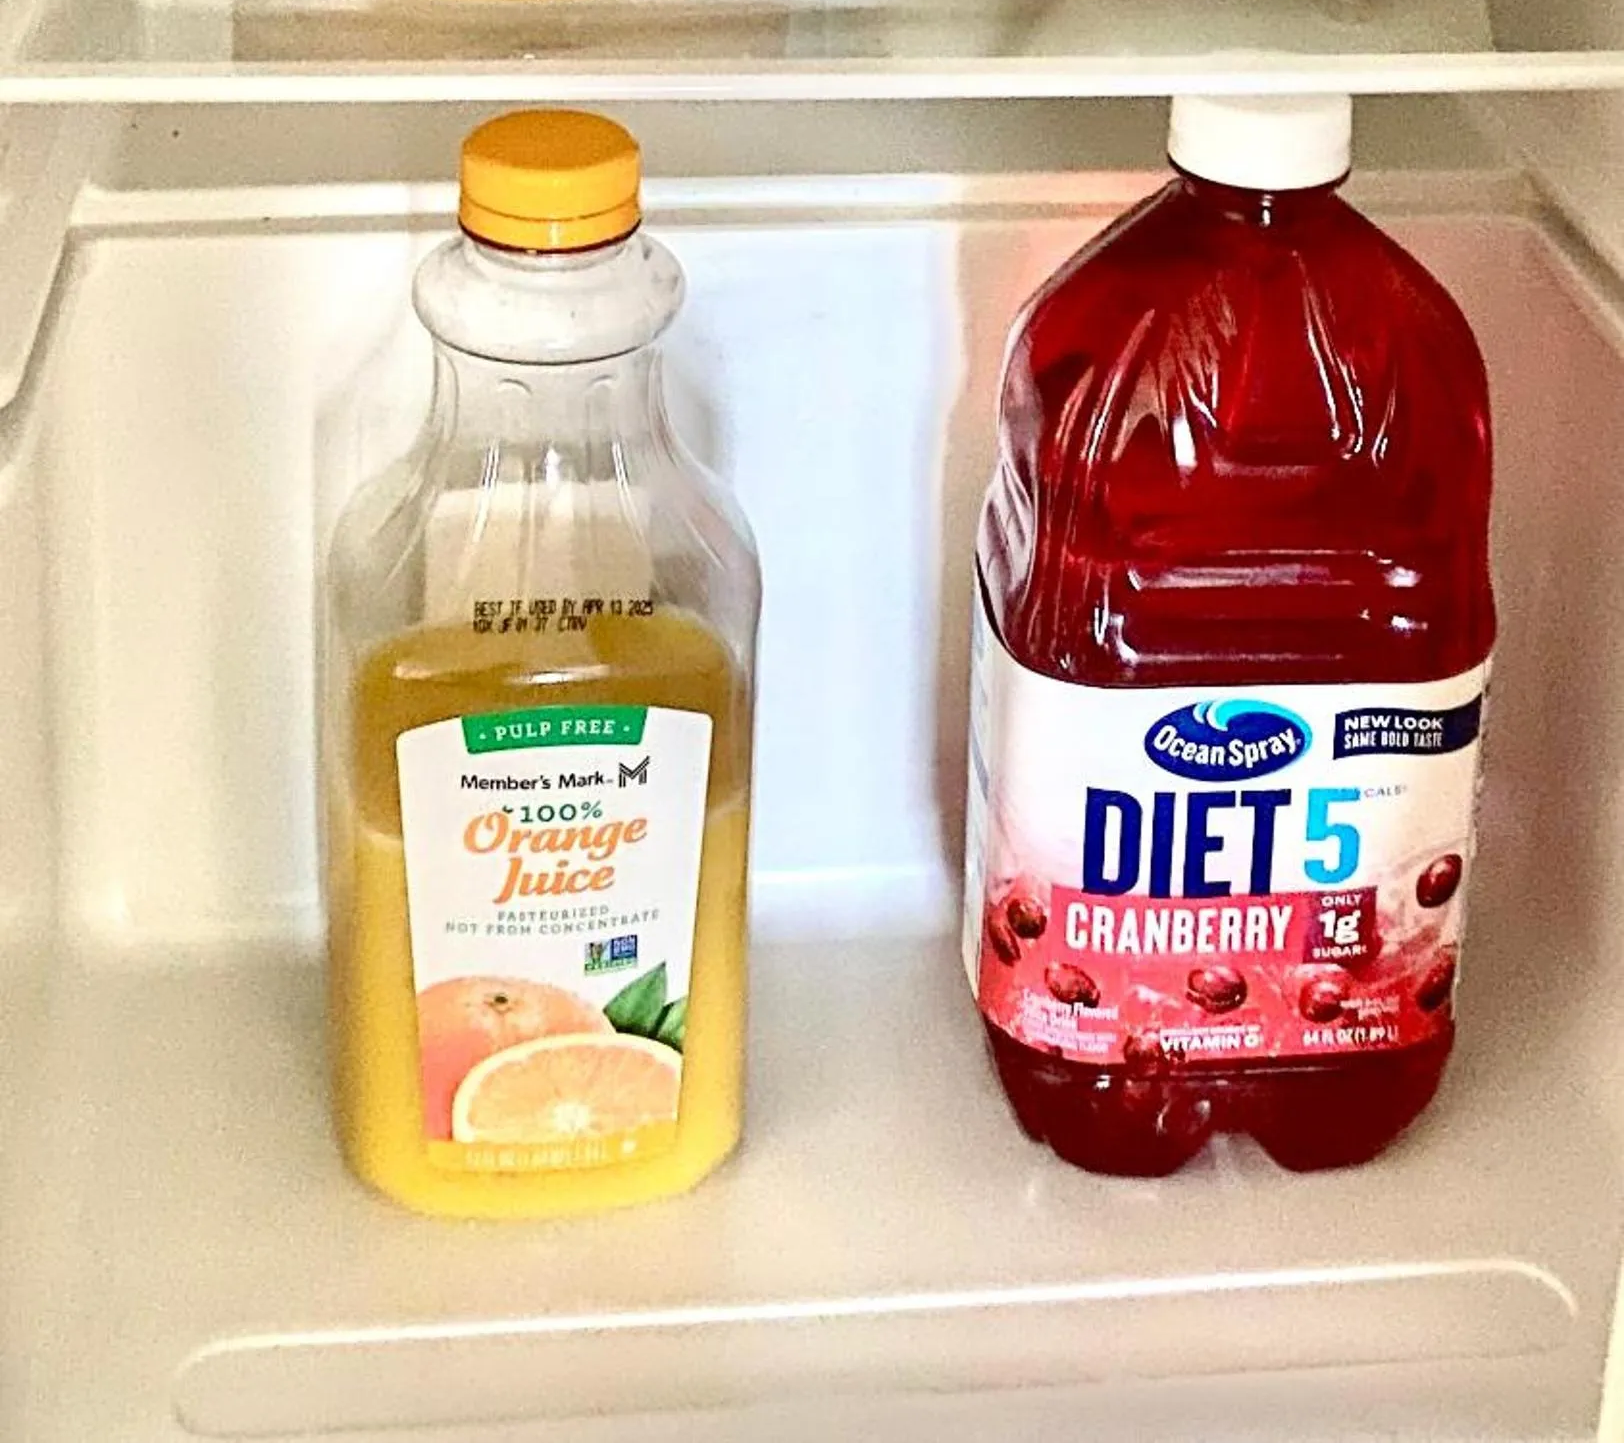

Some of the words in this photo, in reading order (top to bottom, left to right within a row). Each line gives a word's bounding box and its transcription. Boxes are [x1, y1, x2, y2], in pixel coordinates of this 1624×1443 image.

[474, 600, 503, 617] BEST
[510, 600, 523, 616] IF
[529, 599, 557, 615] USED
[563, 598, 577, 615] BY
[583, 598, 604, 615] APR
[494, 720, 551, 741] PULP
[561, 719, 616, 735] FREE
[1344, 715, 1391, 731] NEW
[1394, 717, 1444, 730] LOOK
[1153, 725, 1225, 766] Ocean
[1228, 728, 1297, 768] Spray
[1344, 731, 1376, 749] SAME
[1381, 731, 1409, 747] BOLD
[1413, 732, 1443, 747] TASTE
[460, 773, 551, 790] Member's
[520, 800, 603, 823] 100%
[463, 812, 648, 861] Orange
[1081, 786, 1291, 899] DIET
[1304, 788, 1361, 885] 5
[492, 856, 615, 904] Juice
[446, 921, 478, 935] NOT
[486, 922, 532, 936] FROM
[539, 908, 661, 935] CONCENTRATE
[498, 905, 610, 922] PASTEURIZED
[1066, 902, 1294, 955] CRANBERRY
[1320, 893, 1362, 908] ONLY
[1318, 909, 1361, 945] 1g
[1160, 1035, 1240, 1054] VITAMIN
